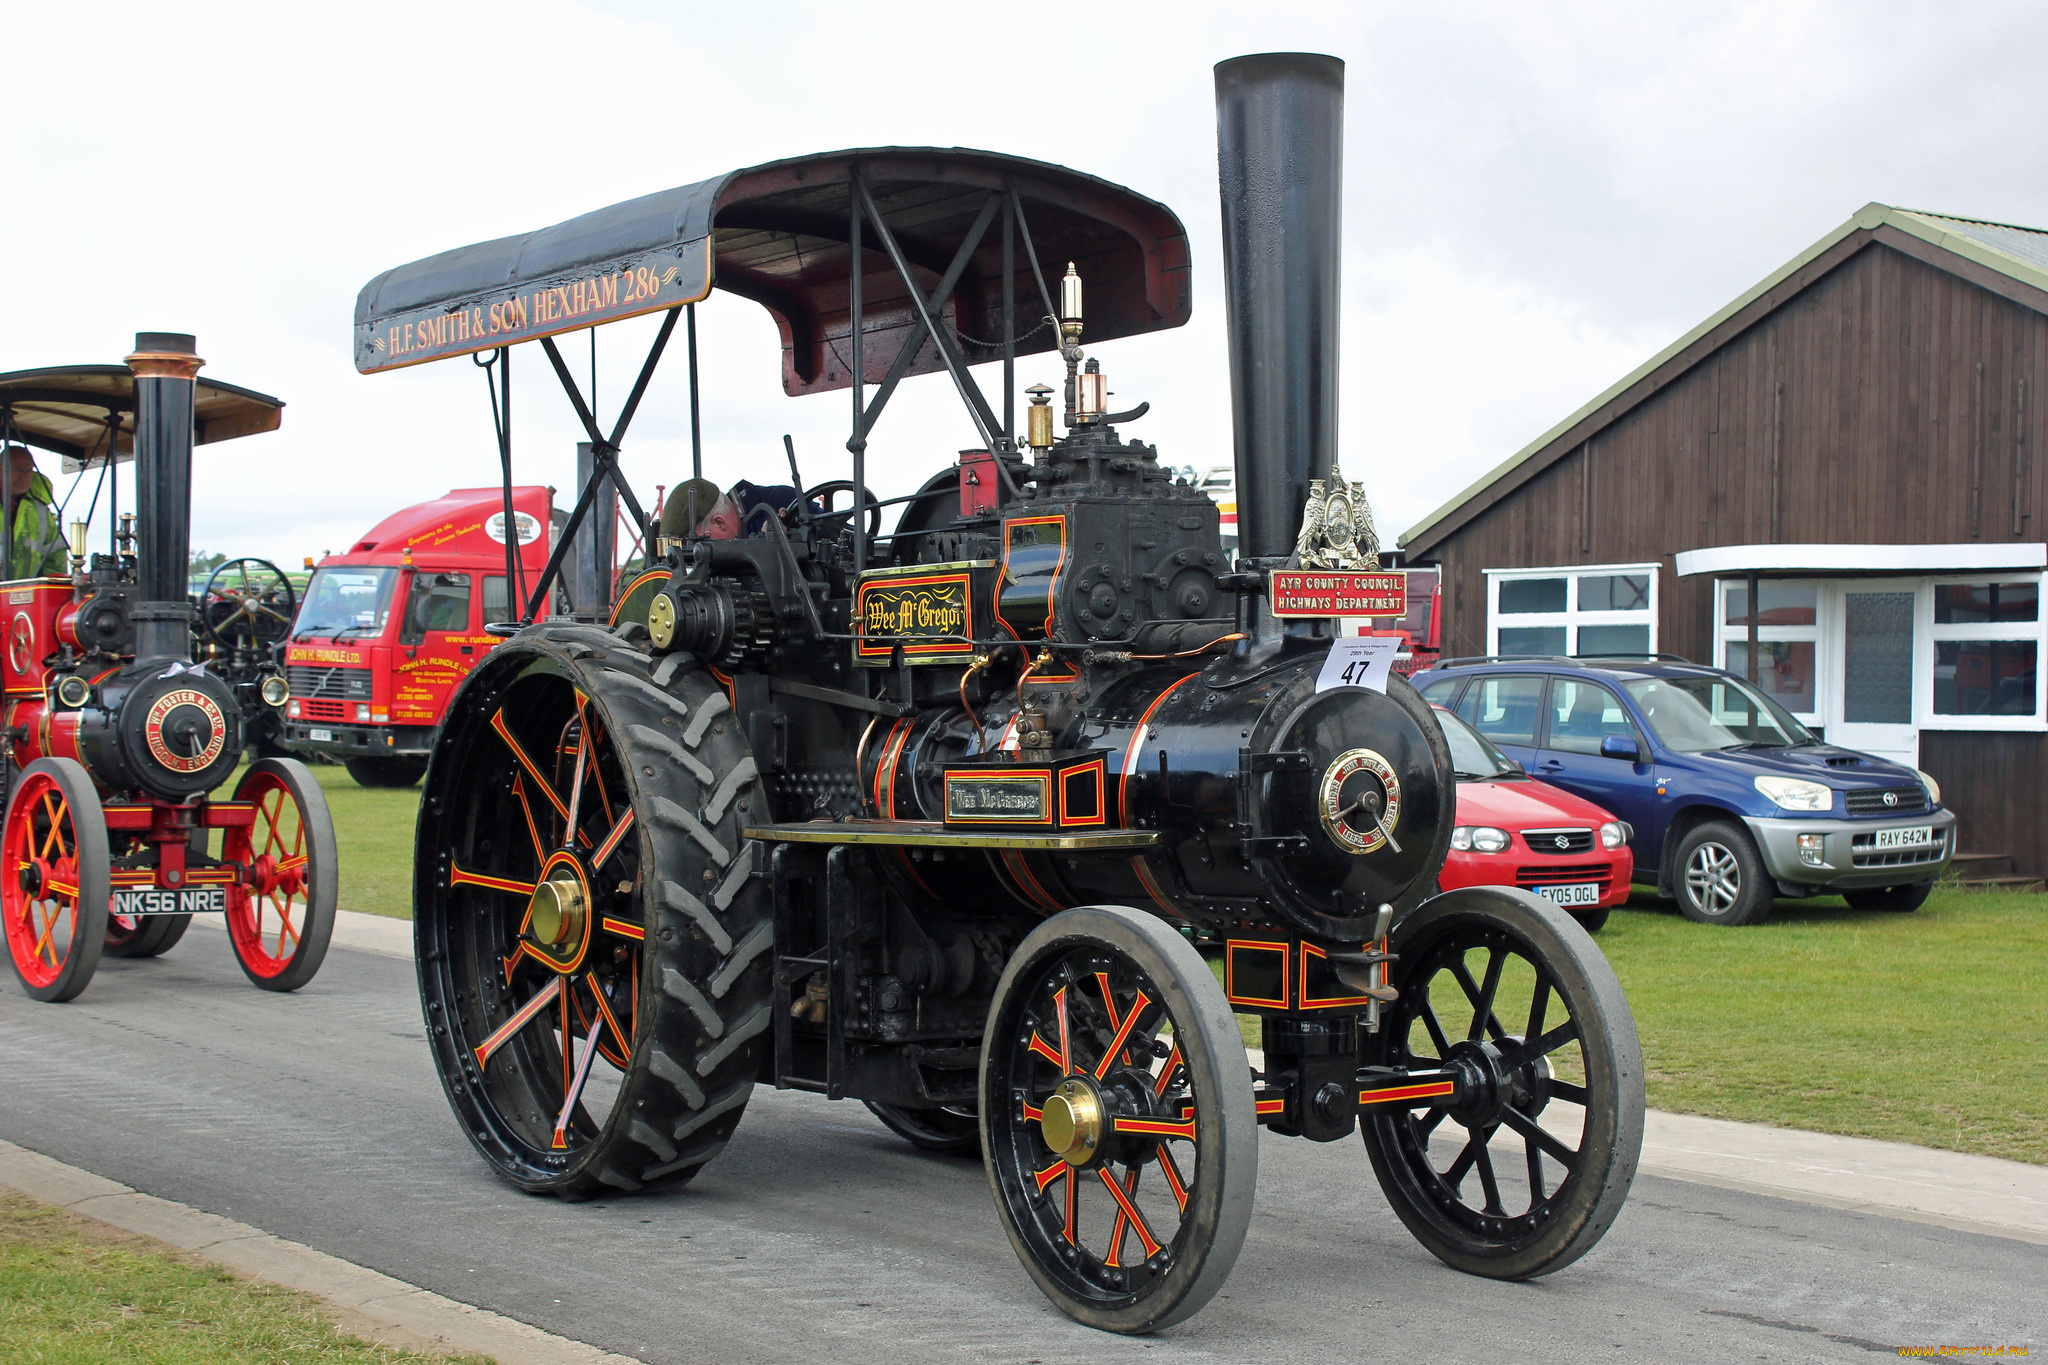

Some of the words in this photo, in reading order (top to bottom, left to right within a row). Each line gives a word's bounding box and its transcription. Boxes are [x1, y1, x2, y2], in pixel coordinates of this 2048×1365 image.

[388, 323, 415, 356] H.F.
[417, 310, 471, 348] SMITH
[472, 307, 487, 338] &
[489, 295, 528, 334] SON
[533, 273, 619, 325] HEXHAM
[622, 263, 660, 304] 286
[1280, 577, 1302, 590] AYR
[1305, 577, 1349, 590] COUNTY
[1278, 596, 1332, 609] HIGHWAYS
[1335, 597, 1402, 610] DEPARTMENT
[869, 601, 896, 631] Wee
[289, 648, 307, 660] JOHN
[316, 649, 346, 663] RUNDLE
[398, 660, 419, 674] JOHN
[429, 657, 460, 670] RUNDLE
[1341, 661, 1370, 685] 47
[158, 692, 195, 711] FOSTER
[197, 697, 205, 706] &
[1880, 832, 1900, 847] RAY
[116, 892, 176, 913] NK56
[180, 891, 224, 911] NRE
[1574, 886, 1597, 902] OGL
